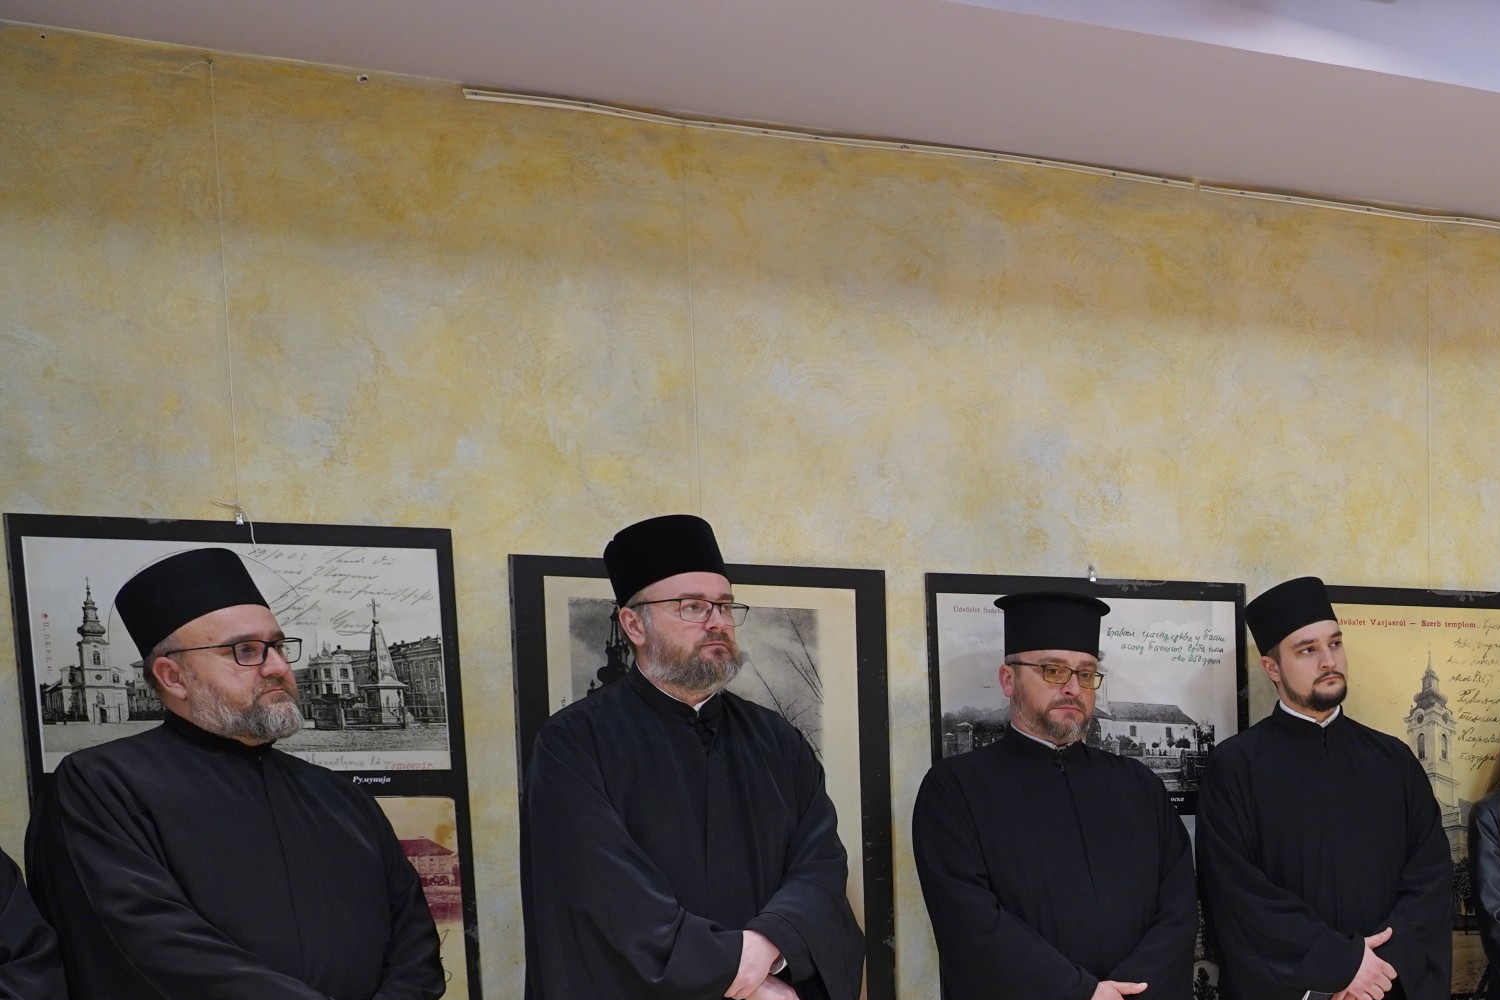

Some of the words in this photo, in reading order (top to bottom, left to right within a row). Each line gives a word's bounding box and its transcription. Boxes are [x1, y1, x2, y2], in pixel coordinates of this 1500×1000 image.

[1339, 618, 1366, 626] dvözlet
[1370, 619, 1407, 629] Varjasról
[1421, 619, 1442, 627] Szerb
[353, 775, 391, 785] Румунија
